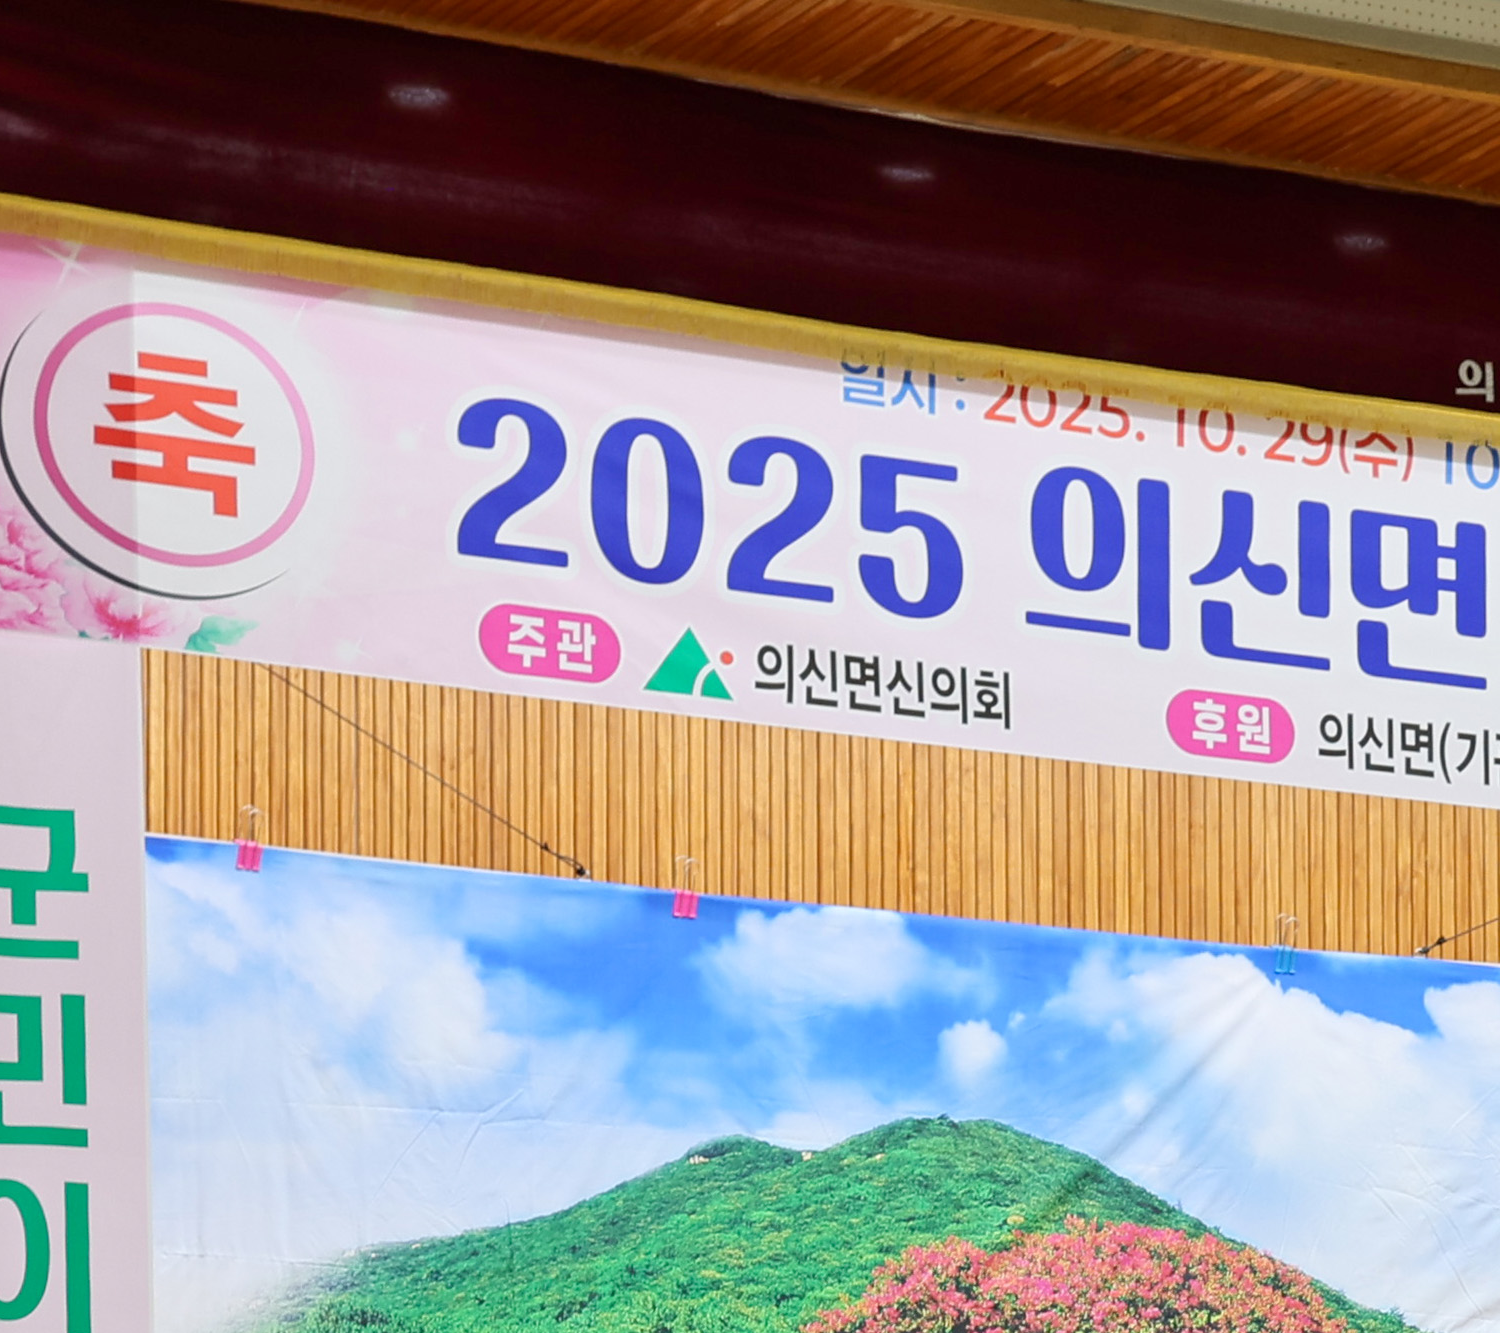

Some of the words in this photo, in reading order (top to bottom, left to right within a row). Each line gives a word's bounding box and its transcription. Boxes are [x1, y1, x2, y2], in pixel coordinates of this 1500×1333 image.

[93, 350, 257, 519] 축
[455, 396, 966, 620] 2025
[1024, 464, 1489, 691] 의신면
[504, 613, 601, 677] 주관
[752, 640, 1014, 732] 의신면신의회
[1191, 698, 1274, 757] 후원
